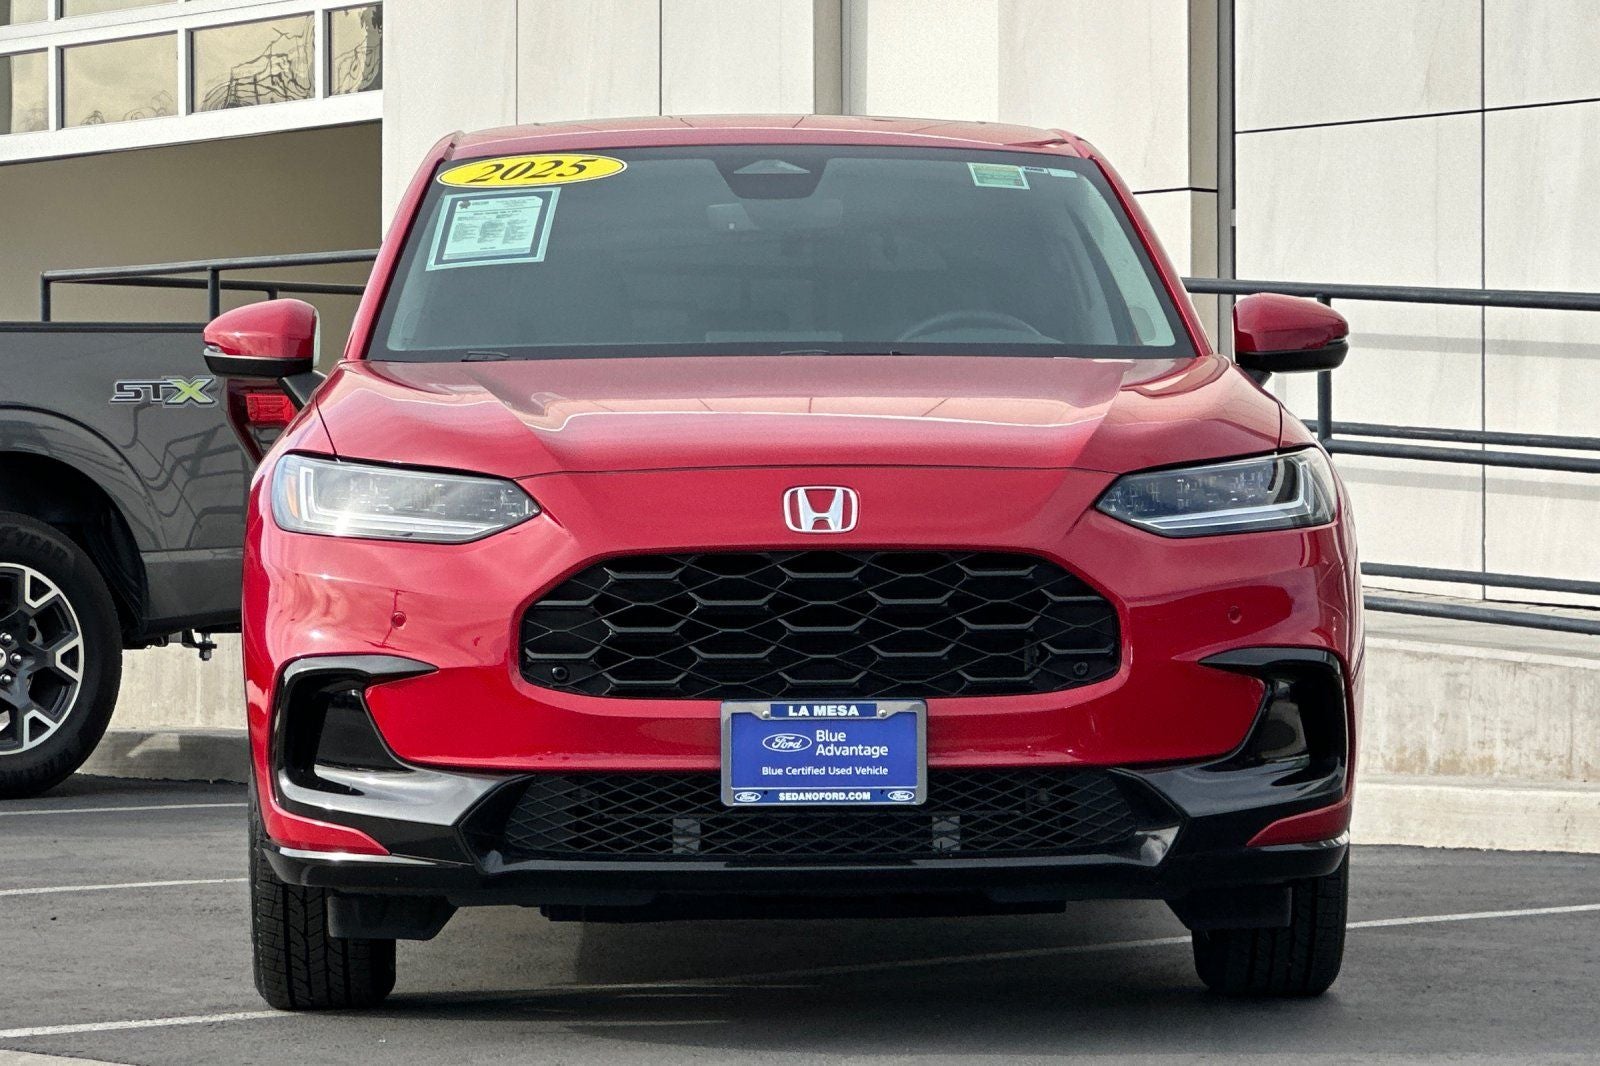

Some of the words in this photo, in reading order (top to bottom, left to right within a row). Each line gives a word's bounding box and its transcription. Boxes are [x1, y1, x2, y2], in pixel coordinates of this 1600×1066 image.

[466, 158, 598, 183] 2025
[110, 377, 215, 405] STX
[788, 705, 810, 717] LA
[813, 705, 860, 717] MESA
[770, 735, 803, 749] Ford
[816, 729, 847, 742] Blue
[816, 744, 889, 758] Advantage
[762, 766, 784, 775] Blue
[785, 766, 826, 775] Certified
[828, 766, 852, 775] Used
[854, 766, 889, 775] Vehicle
[778, 792, 871, 801] SEDANOFORD.COM
